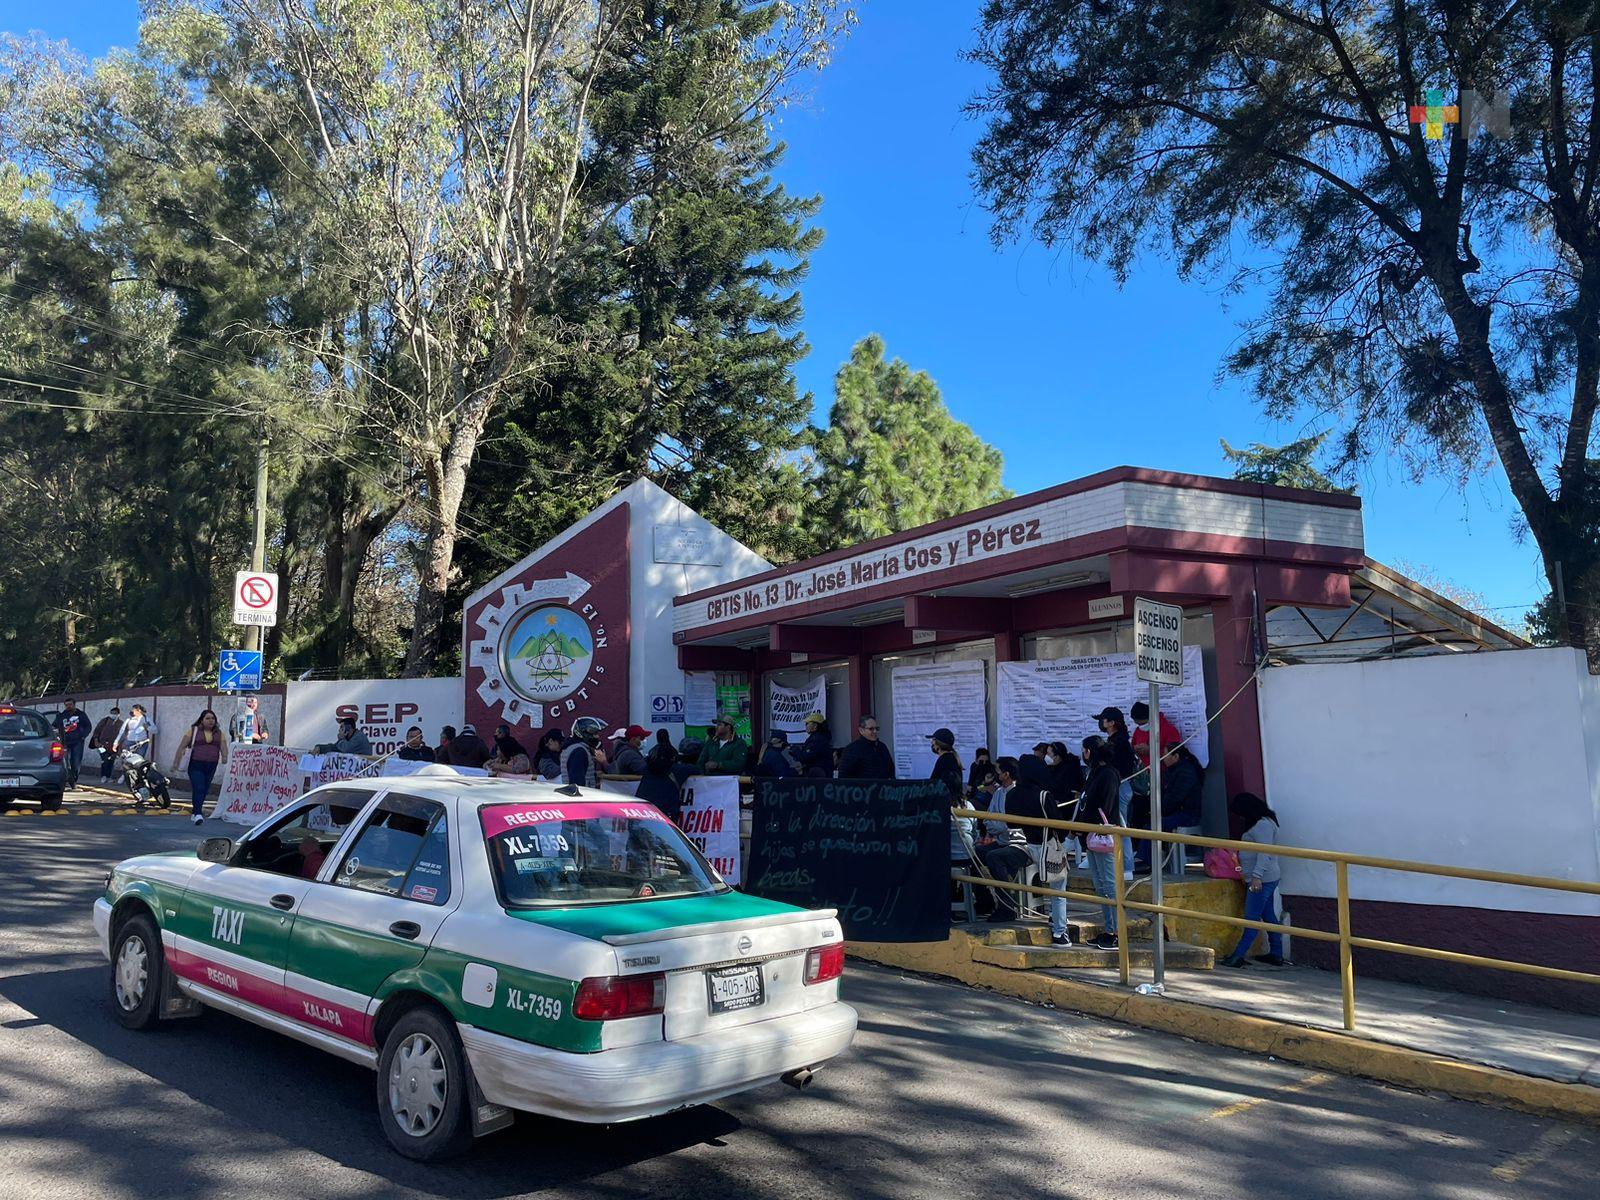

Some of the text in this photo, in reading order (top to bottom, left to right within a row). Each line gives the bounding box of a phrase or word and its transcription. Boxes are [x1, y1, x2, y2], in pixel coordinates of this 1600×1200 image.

[707, 518, 1042, 621] CBTIS No. 13 Dr. José María Cos y Pérez
[237, 612, 273, 624] TERMINA
[1137, 609, 1178, 631] ASCENSO
[1137, 633, 1179, 653] DESCENSO
[1084, 662, 1112, 670] DIFERENTES
[1138, 655, 1180, 676] ESCOLARES
[335, 703, 423, 725] S.E.P.
[360, 726, 397, 738] Clave
[349, 758, 355, 772] 2
[761, 781, 789, 807] Por
[795, 784, 816, 804] un
[823, 782, 877, 805] error
[503, 807, 668, 827] REGION XALAPA
[765, 813, 780, 833] de
[787, 811, 803, 833] la
[503, 834, 569, 856] XL-7359
[800, 841, 816, 854] se
[819, 833, 892, 860] quedaron
[896, 836, 919, 857] sin
[211, 905, 246, 945] TAXI
[207, 967, 239, 991] REGION
[721, 966, 748, 976] NISSAN
[302, 1001, 344, 1028] XALAPA
[506, 987, 562, 1020] XL-7359
